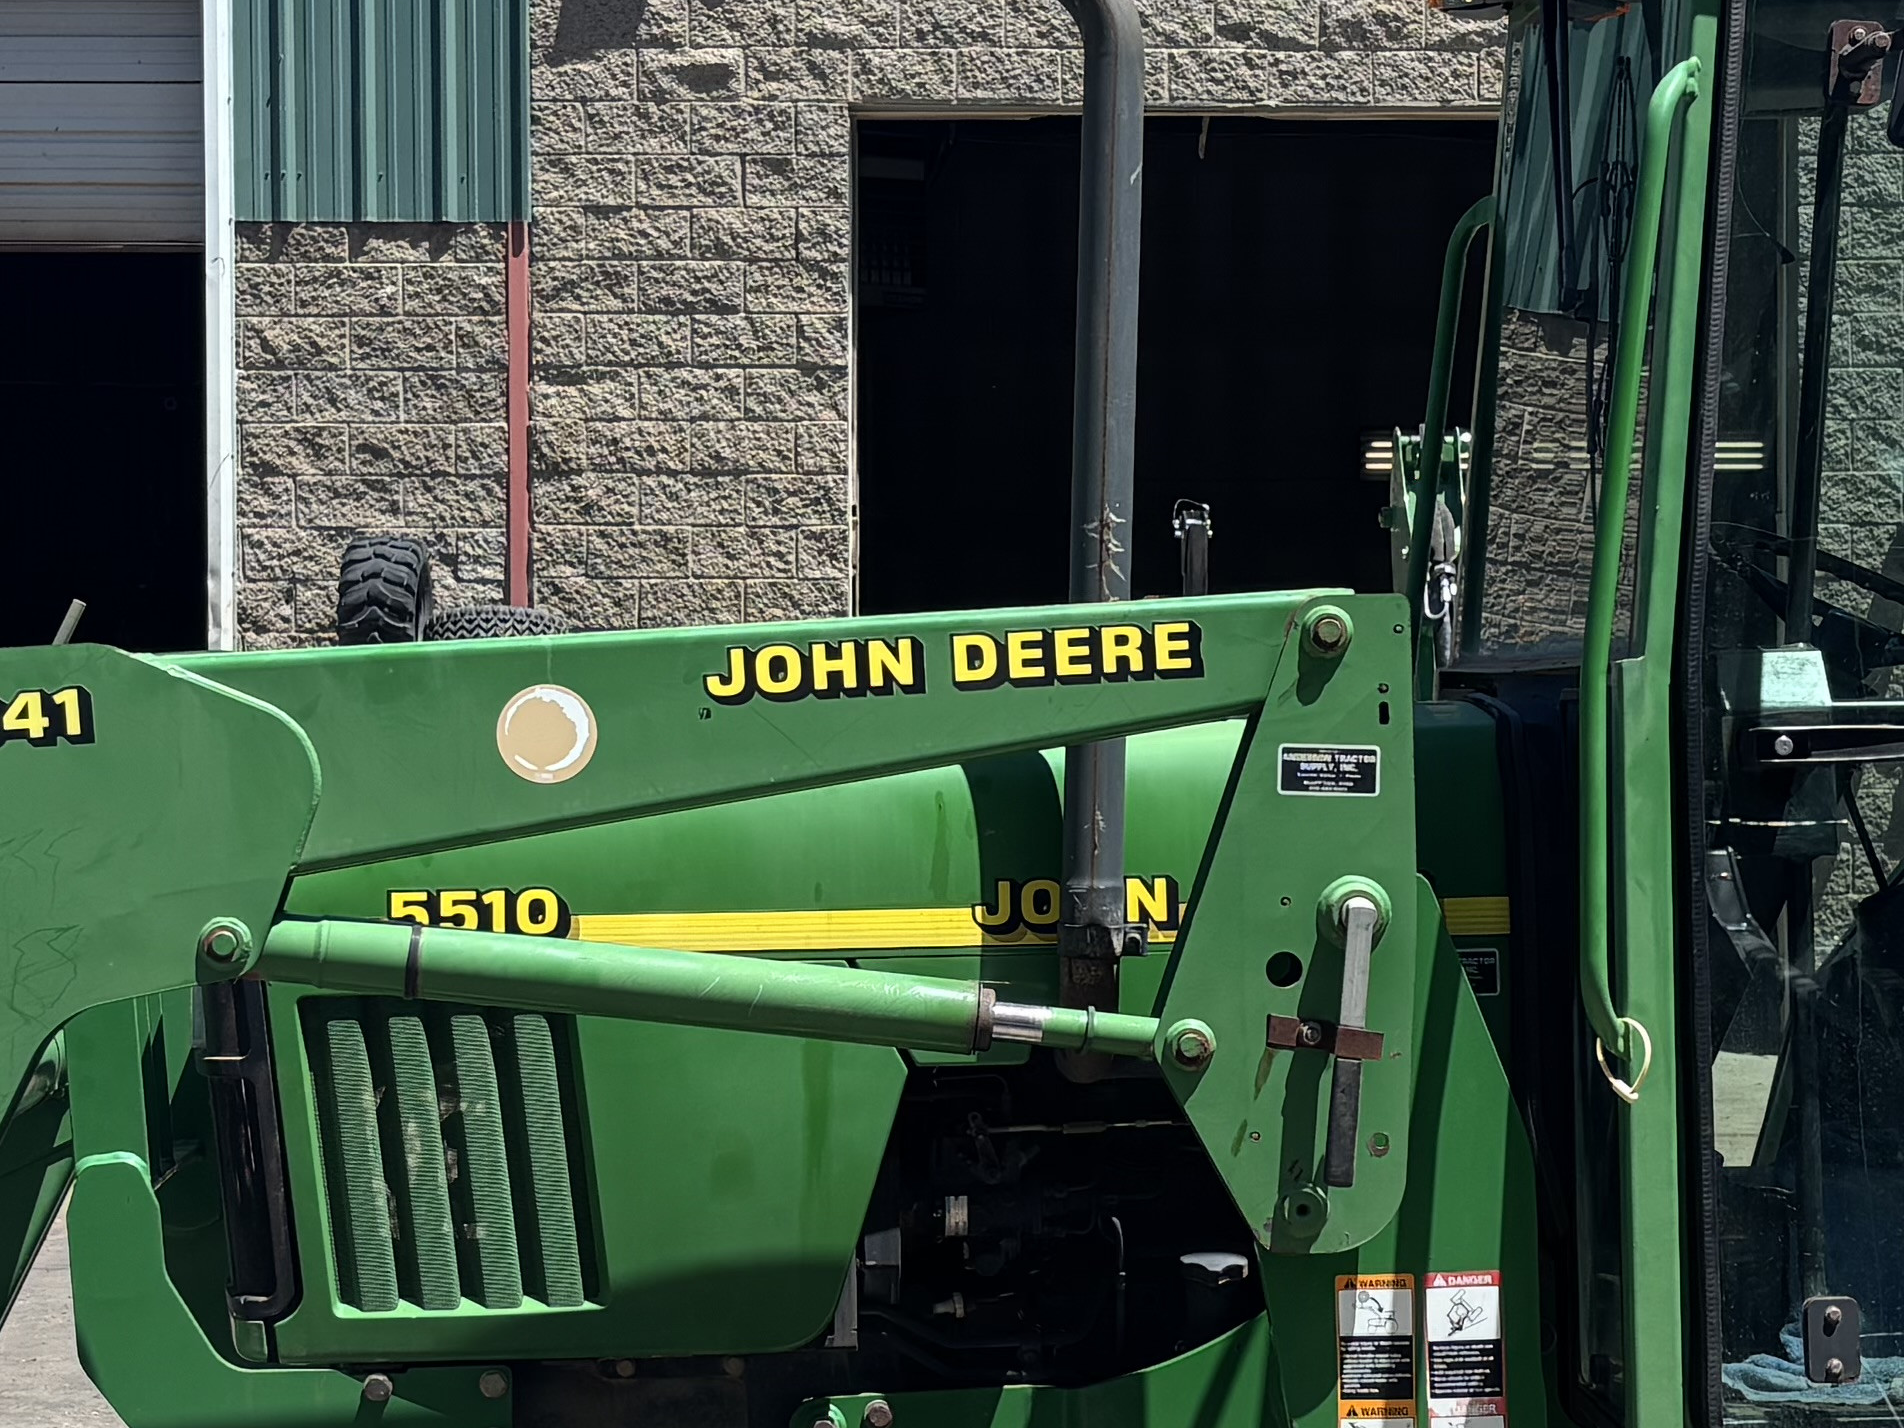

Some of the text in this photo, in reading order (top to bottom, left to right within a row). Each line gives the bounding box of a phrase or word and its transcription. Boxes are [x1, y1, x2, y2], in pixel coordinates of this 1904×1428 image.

[704, 621, 1197, 698] JOHN DEERE
[389, 888, 560, 936] 5510
[972, 877, 1170, 926] JON
[1358, 1278, 1408, 1289] WARNING
[1447, 1274, 1492, 1286] DANGER
[1360, 1406, 1409, 1417] WARNING
